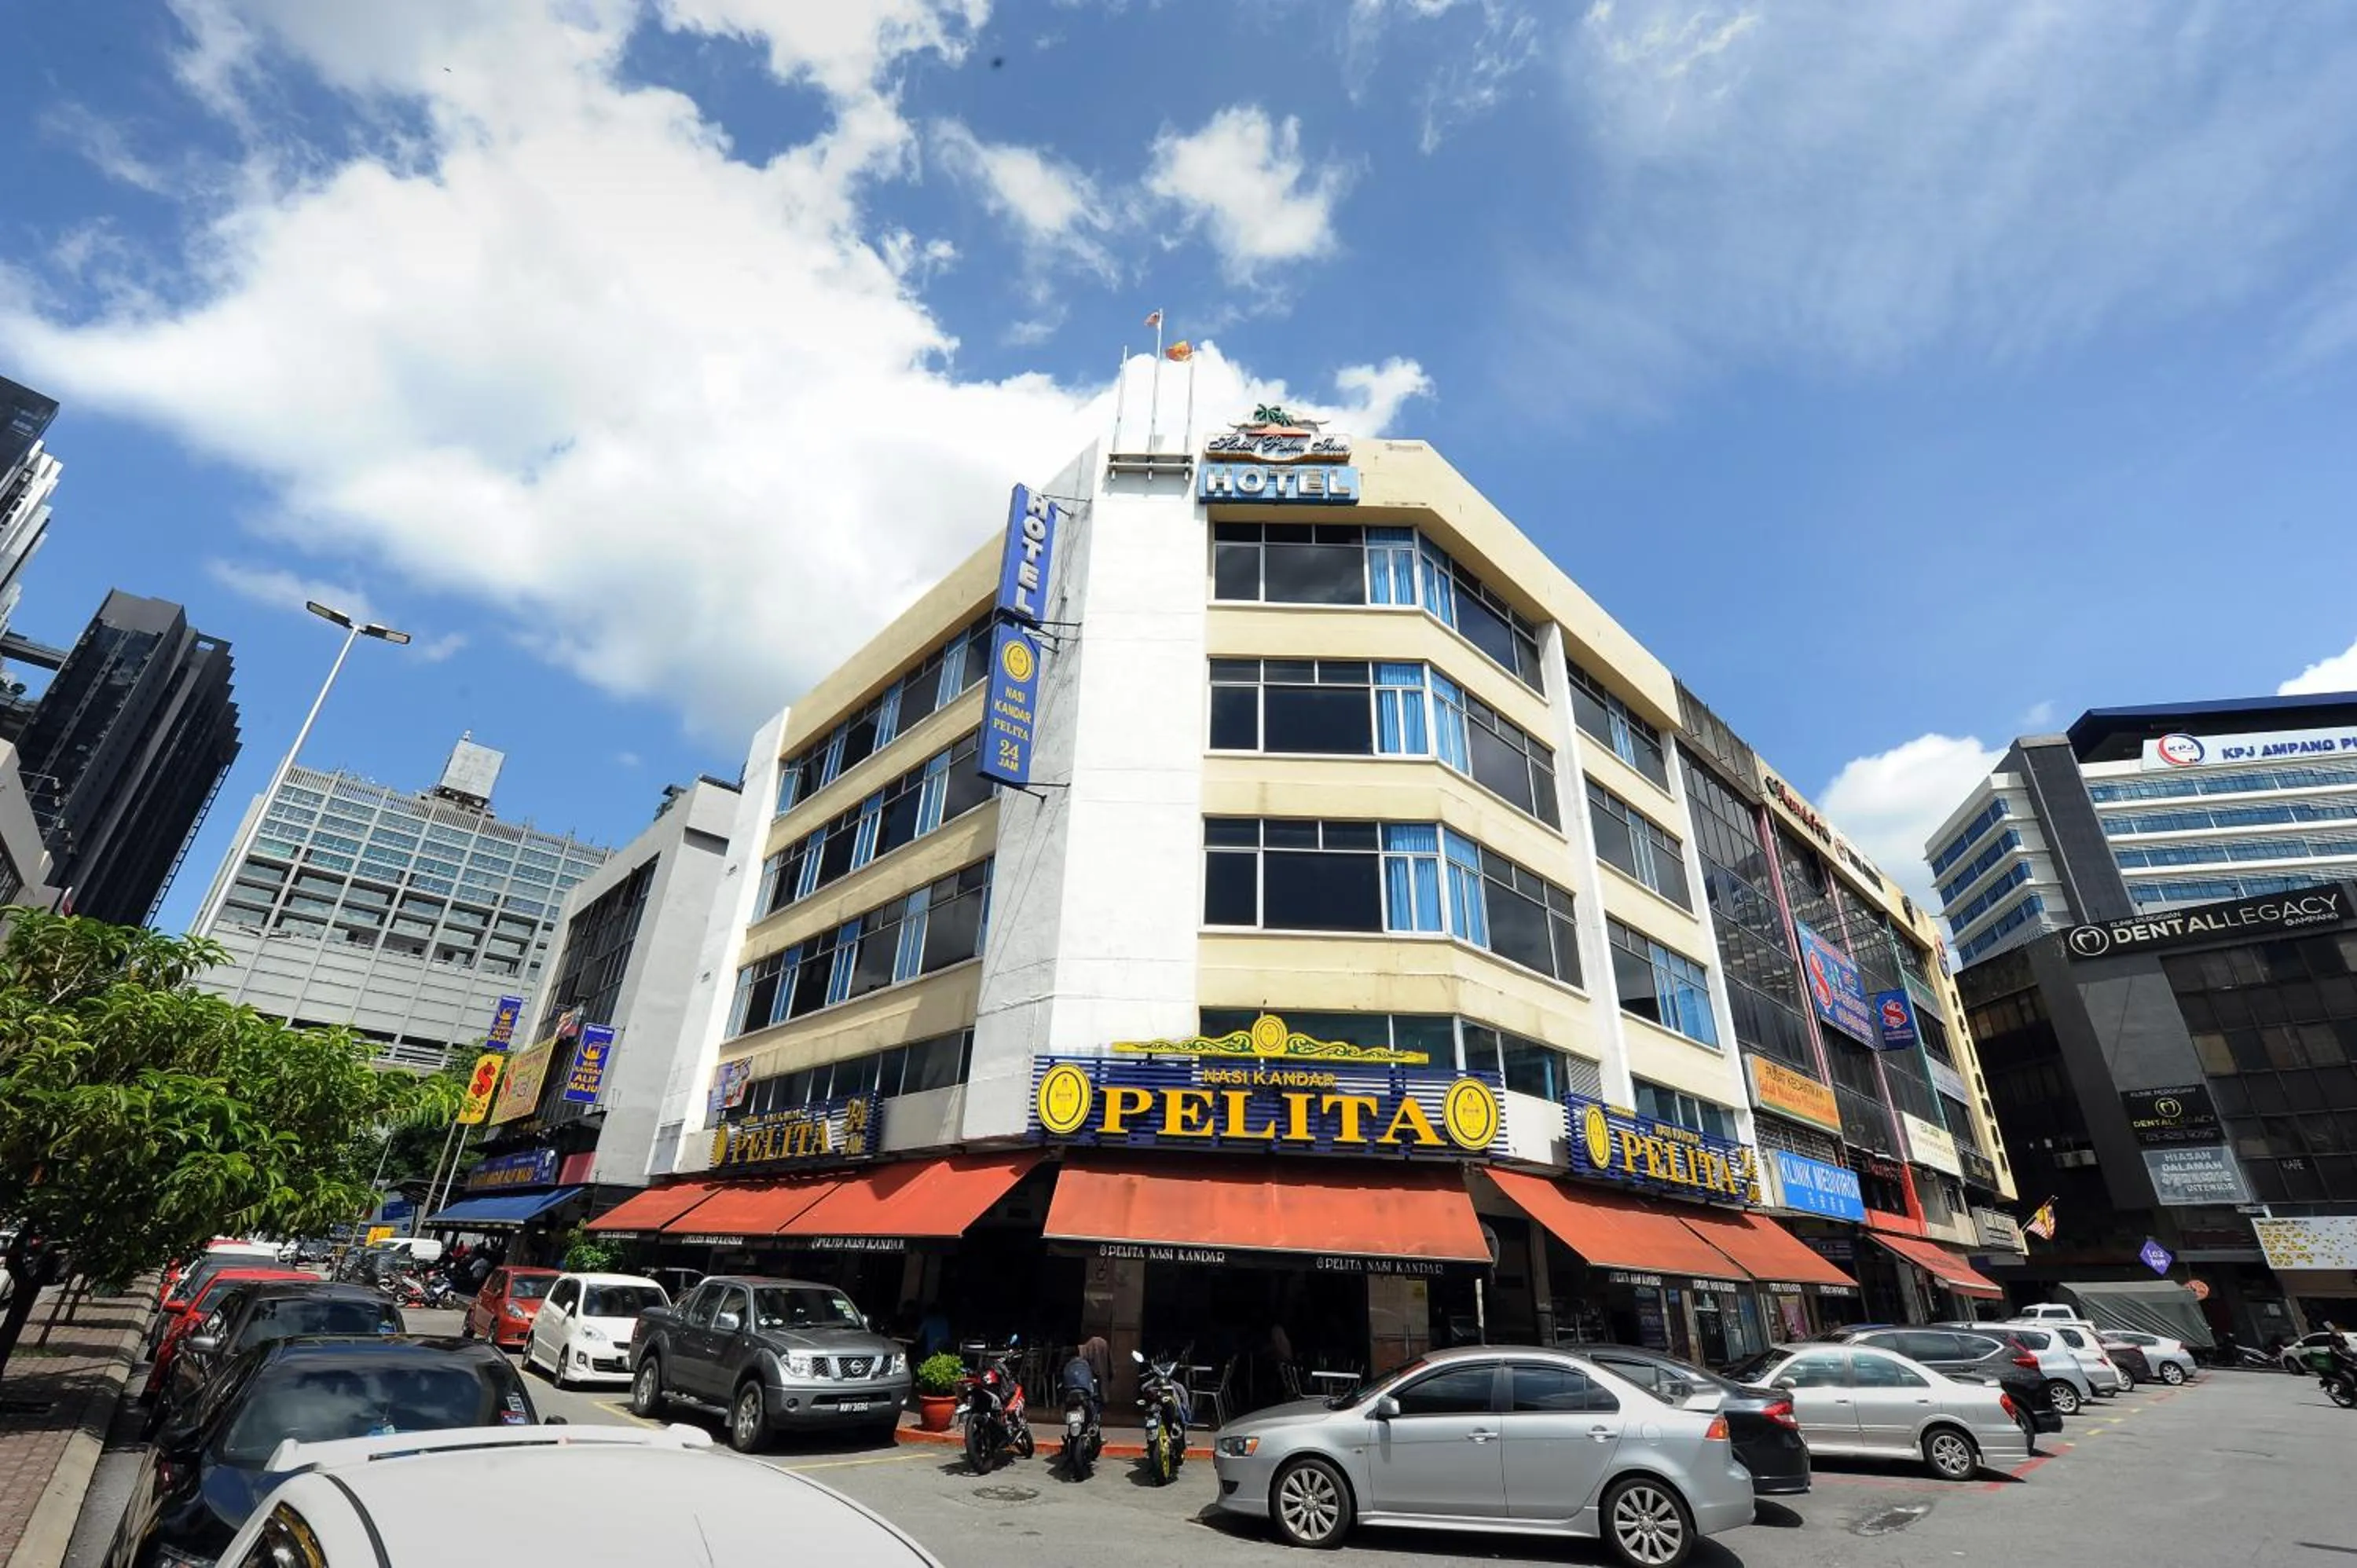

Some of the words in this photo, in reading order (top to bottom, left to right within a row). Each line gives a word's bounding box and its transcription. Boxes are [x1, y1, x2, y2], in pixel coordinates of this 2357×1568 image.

[1206, 467, 1351, 496] HOTEL
[1014, 489, 1049, 617] HOTEL
[1005, 686, 1025, 705] NASI
[993, 698, 1032, 724] KANDAR
[992, 717, 1030, 742] PELITA
[999, 738, 1020, 761] 24
[2223, 747, 2255, 760] KPJ
[2262, 739, 2334, 757] AMPANG
[996, 757, 1020, 772] JAM
[568, 1082, 599, 1093] MAJU
[574, 1074, 598, 1084] ALIF
[1203, 1068, 1248, 1085] NASI
[1253, 1071, 1336, 1088] KANDAR
[1095, 1086, 1448, 1146] PELITA
[731, 1120, 833, 1163] PELITA
[1618, 1130, 1739, 1196] PELITA
[1108, 1246, 1145, 1258] PELITA
[1149, 1247, 1174, 1261] NASI
[1178, 1251, 1226, 1262] KANDAR
[1325, 1258, 1362, 1270] PELITA
[1366, 1259, 1391, 1272] NASI
[1396, 1263, 1443, 1275] KANDAR
